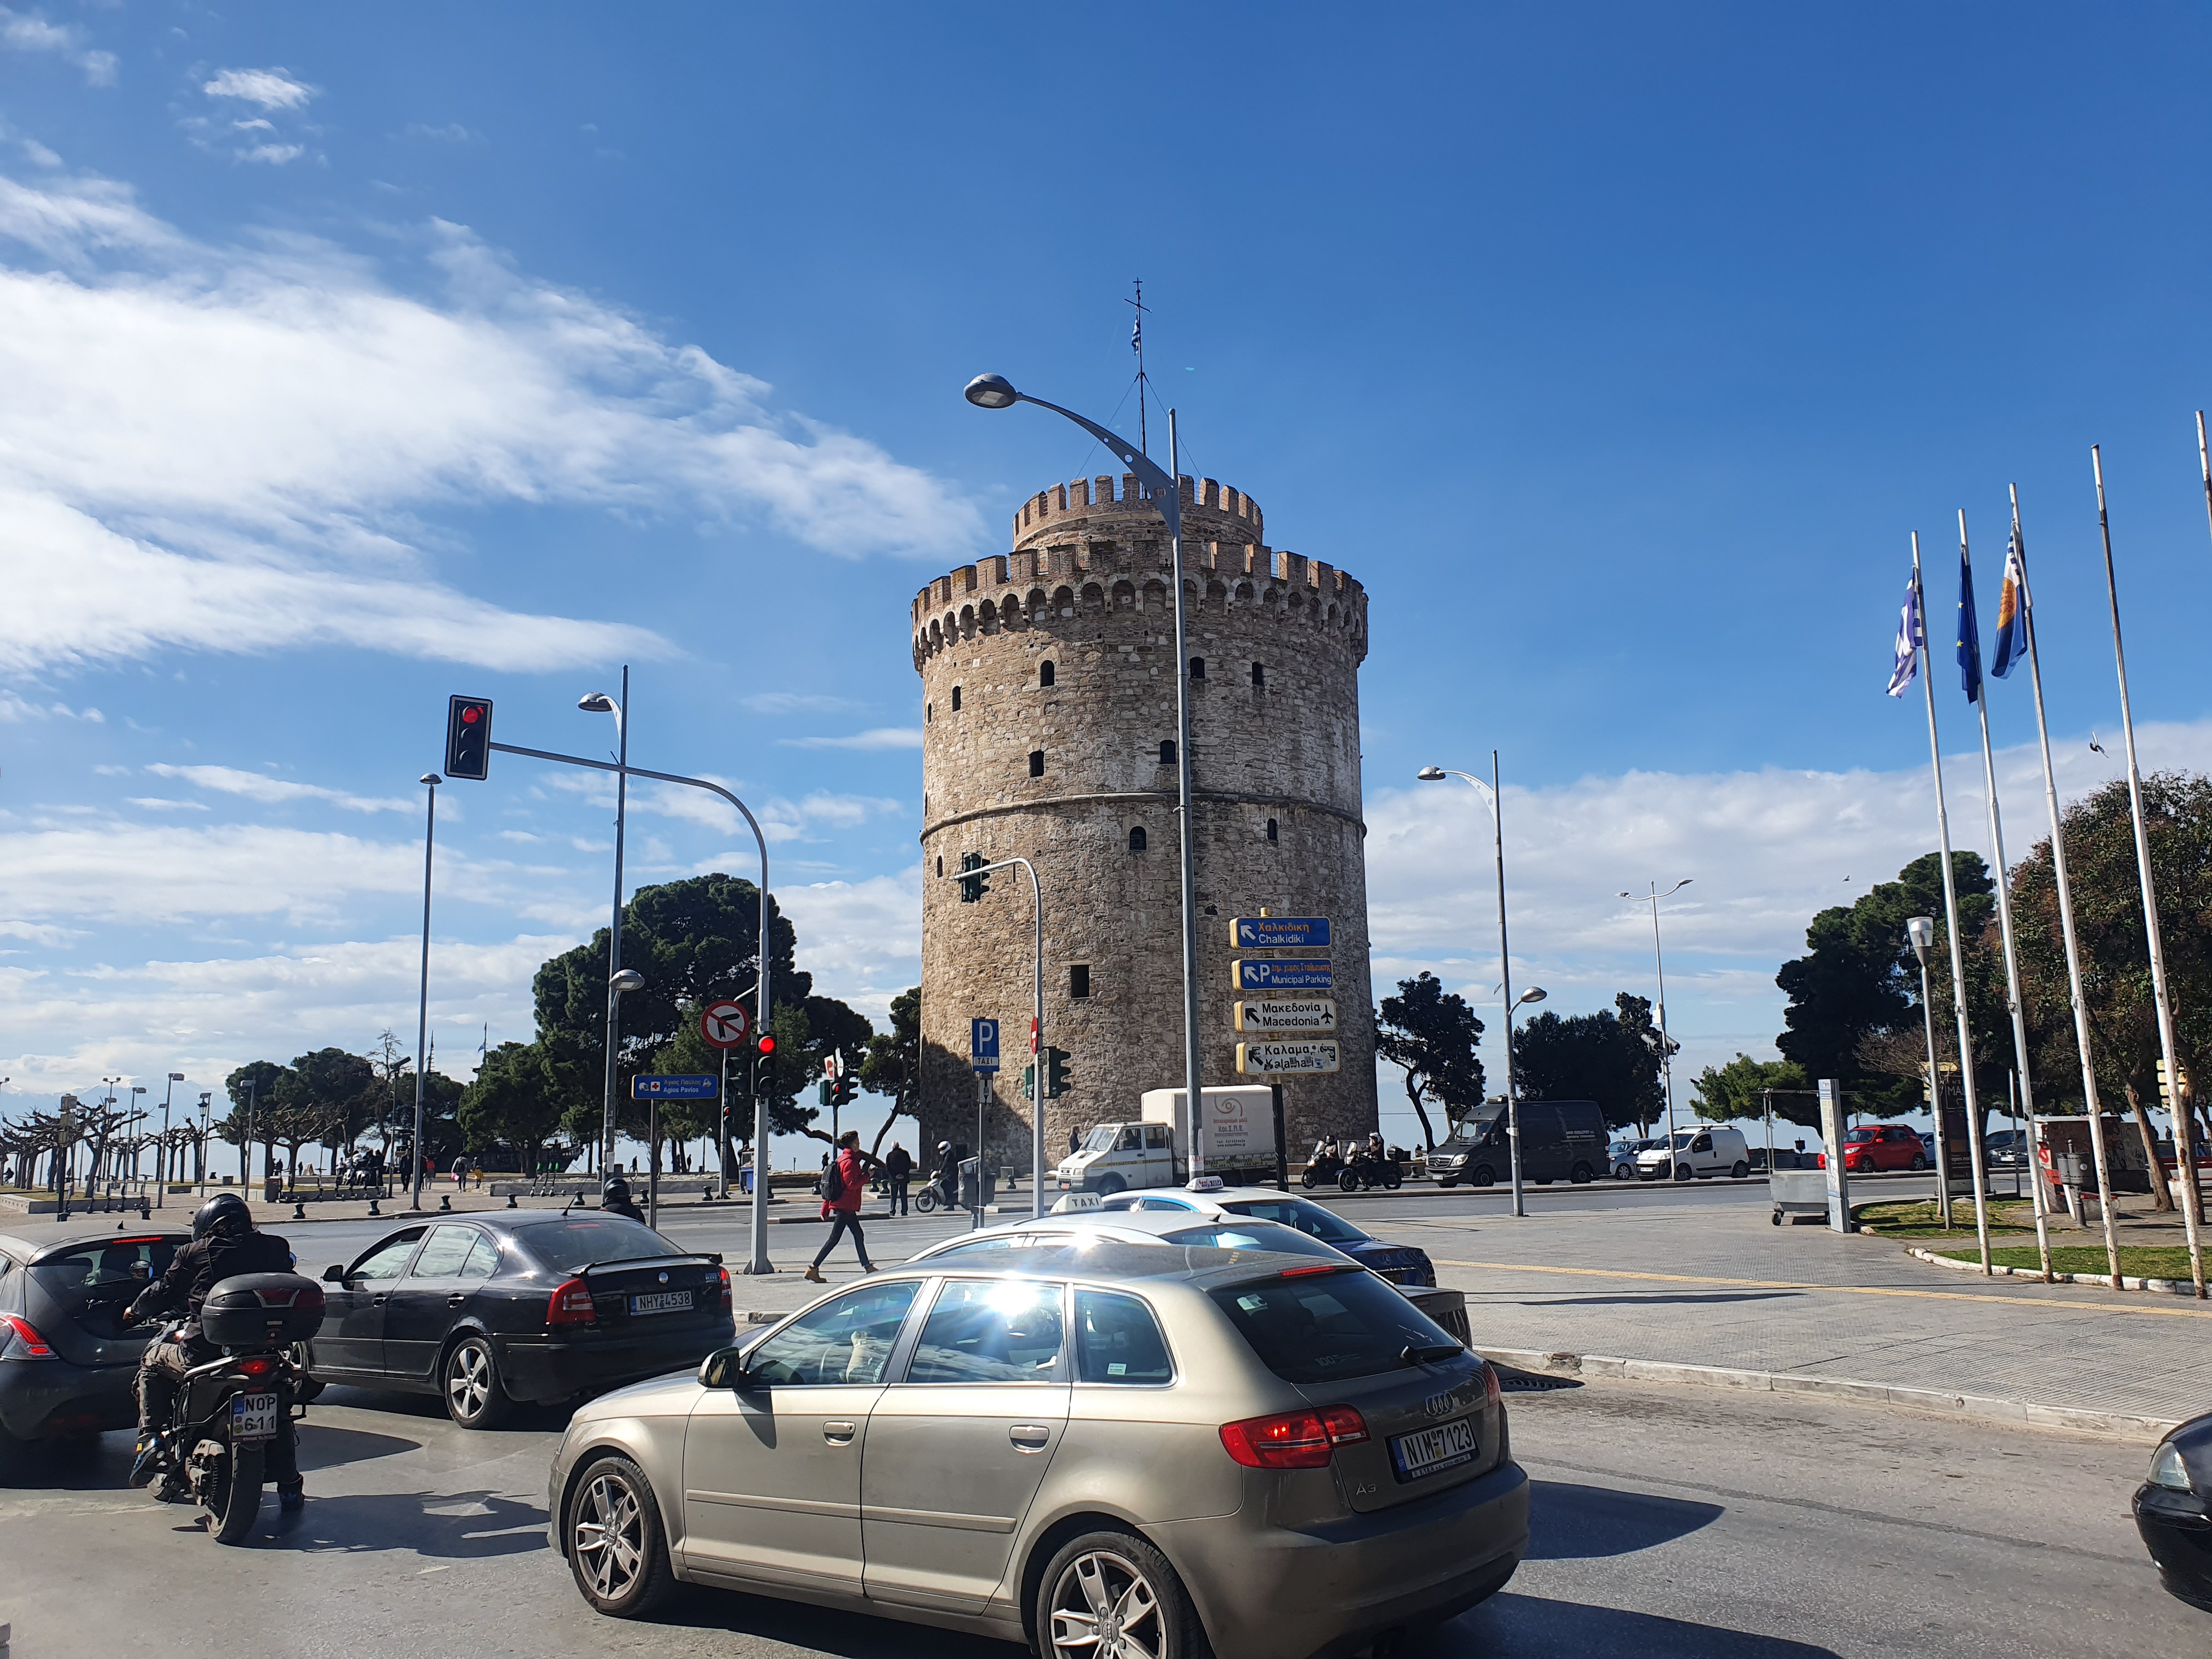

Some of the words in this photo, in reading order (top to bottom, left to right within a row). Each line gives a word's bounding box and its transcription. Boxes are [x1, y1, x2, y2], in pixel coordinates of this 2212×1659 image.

[1258, 922, 1310, 933] Χαλκιδική
[1259, 933, 1304, 944] Chalkidiki
[1260, 964, 1270, 983] P
[1271, 975, 1304, 985] Municipal
[1305, 974, 1331, 985] Parking
[1262, 1002, 1321, 1013] Μακεδονία
[1262, 1016, 1319, 1026] Macedonia
[979, 1022, 994, 1053] P
[1071, 1197, 1099, 1207] TAXI
[245, 1396, 276, 1412] NOP
[245, 1415, 274, 1431] 611
[1356, 1482, 1376, 1496] A3
